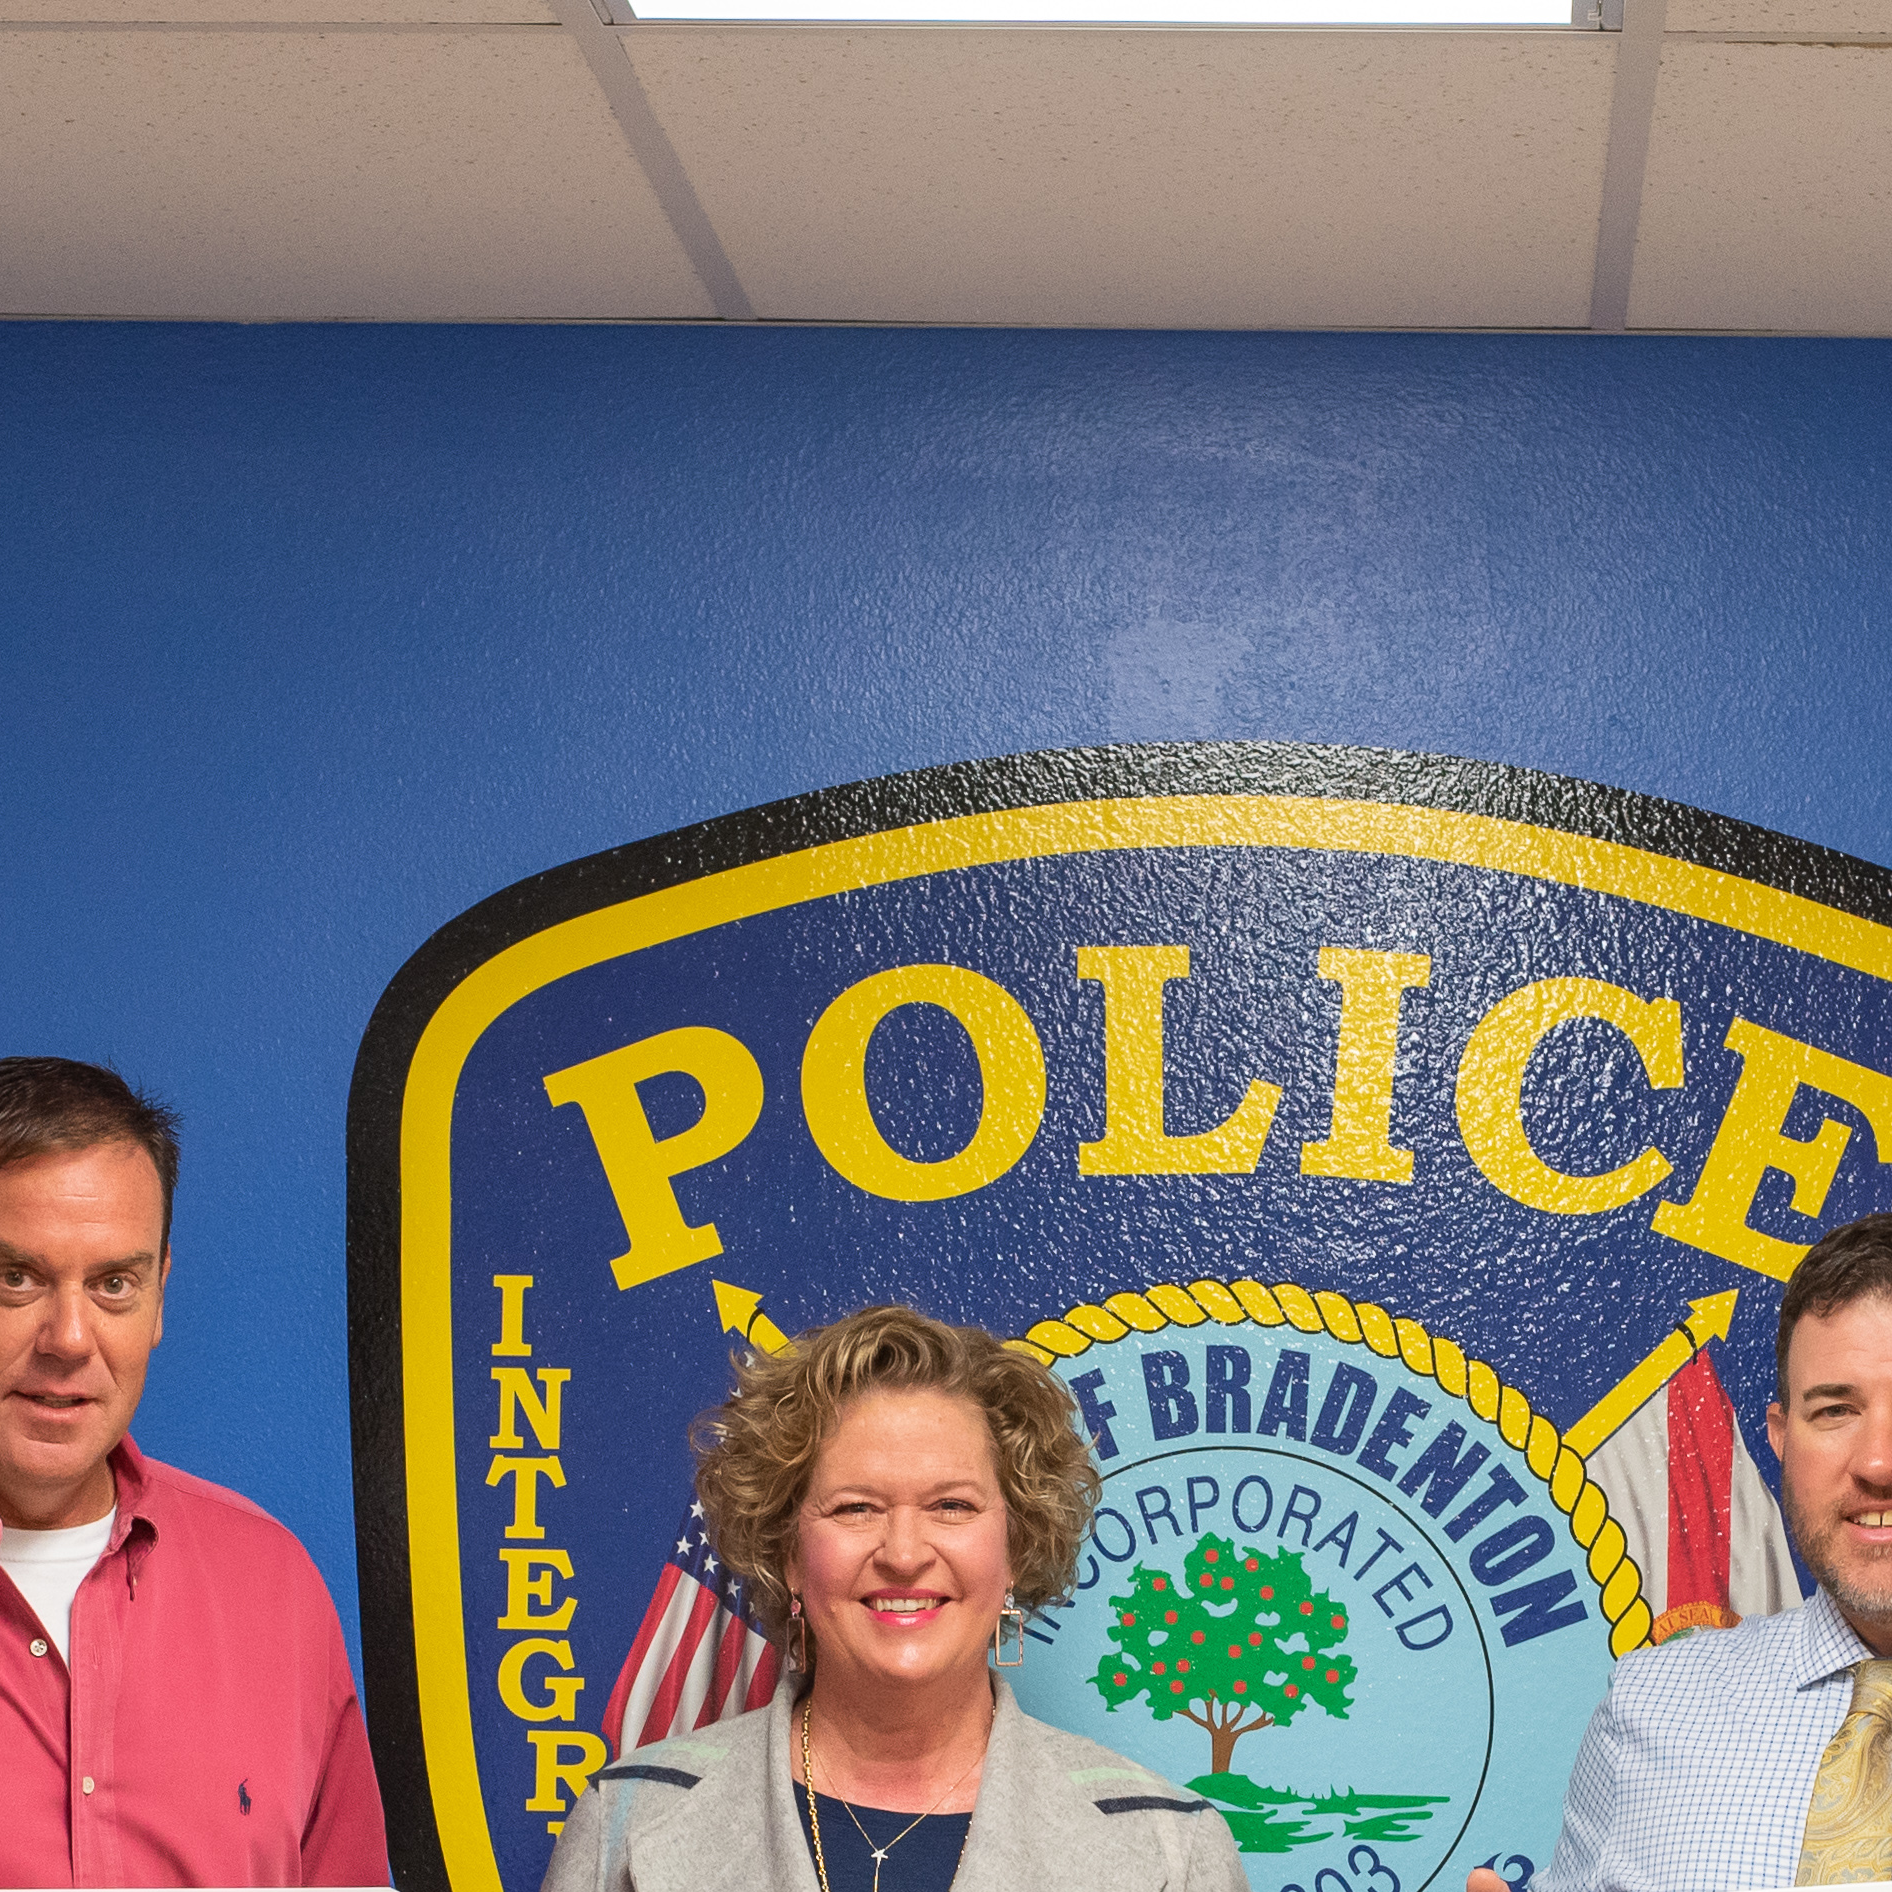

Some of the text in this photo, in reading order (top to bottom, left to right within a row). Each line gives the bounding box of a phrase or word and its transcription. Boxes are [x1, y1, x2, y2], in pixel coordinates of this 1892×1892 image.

[485, 1274, 608, 1838] INTEGR
[1068, 1343, 1589, 1648] F BRADENTON
